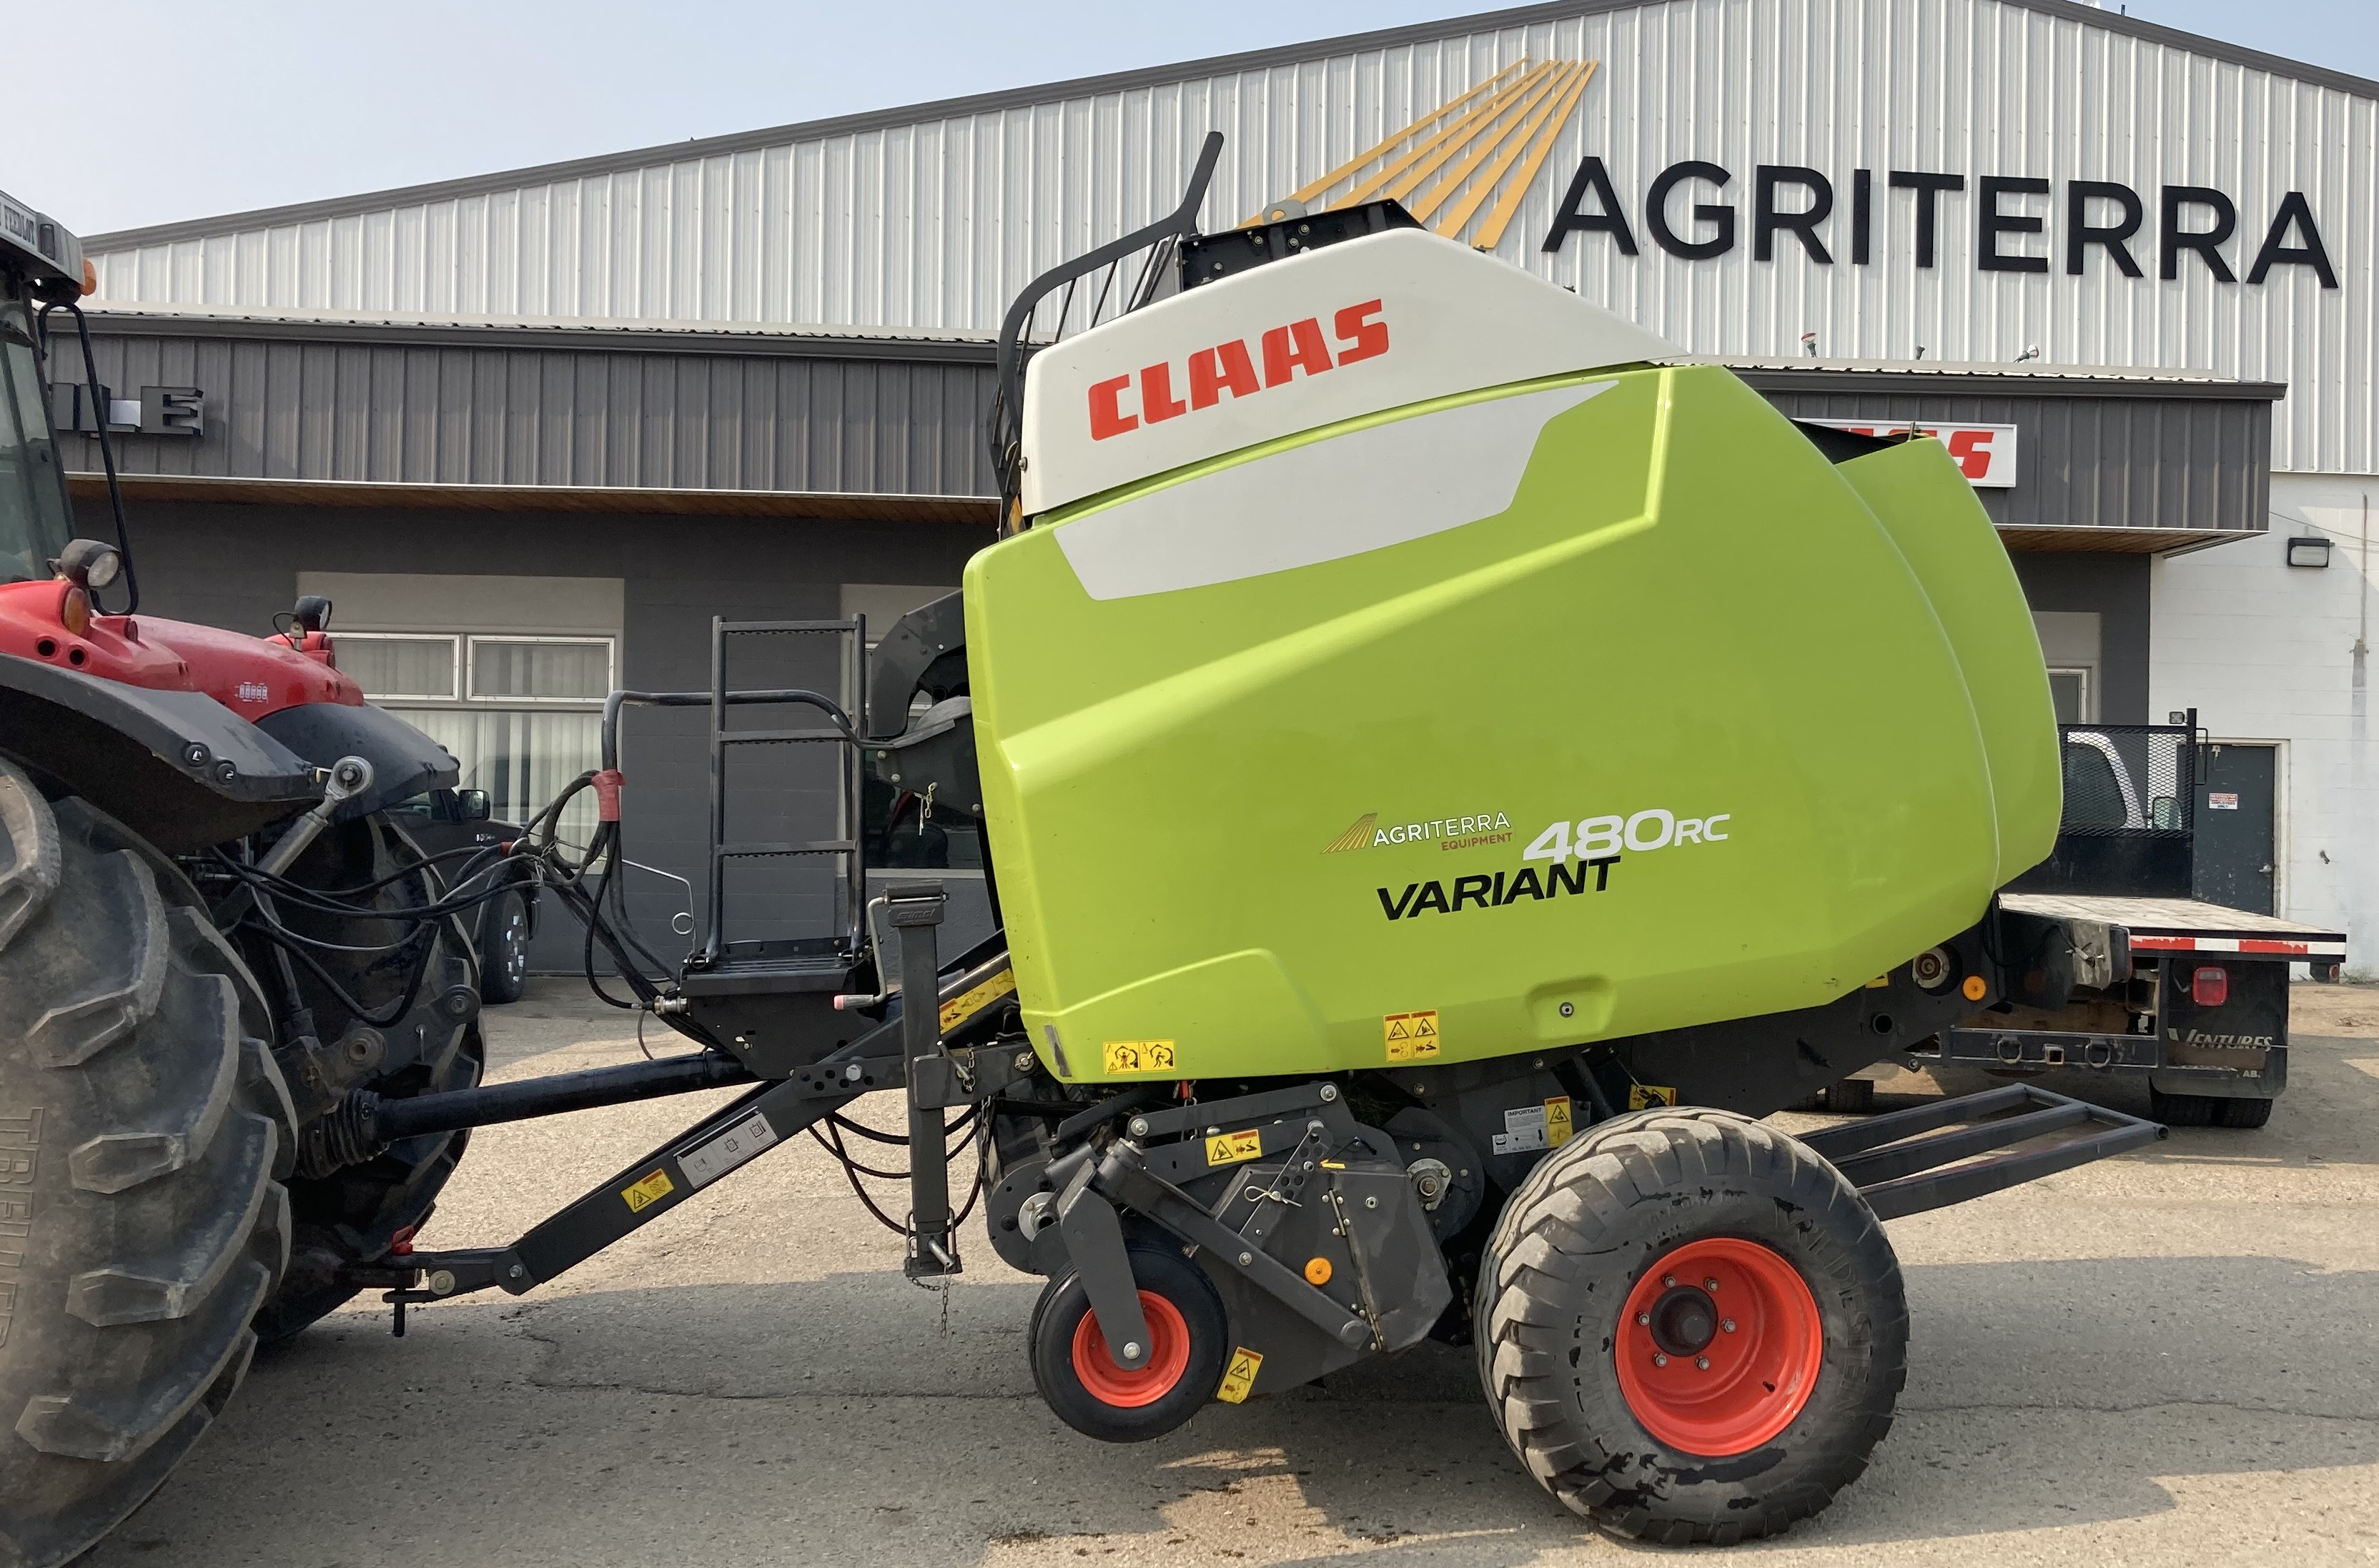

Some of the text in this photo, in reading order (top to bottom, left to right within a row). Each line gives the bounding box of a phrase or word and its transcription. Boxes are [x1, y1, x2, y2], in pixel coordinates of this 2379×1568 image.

[1540, 156, 2339, 289] AGRITERRA
[1088, 298, 1390, 442] CLAAS
[1372, 811, 1510, 848] AGRITERRA
[1441, 832, 1513, 852] EQUIPMENT
[1377, 855, 1621, 921] VARIANT
[1507, 1107, 1542, 1117] IMPORTANT
